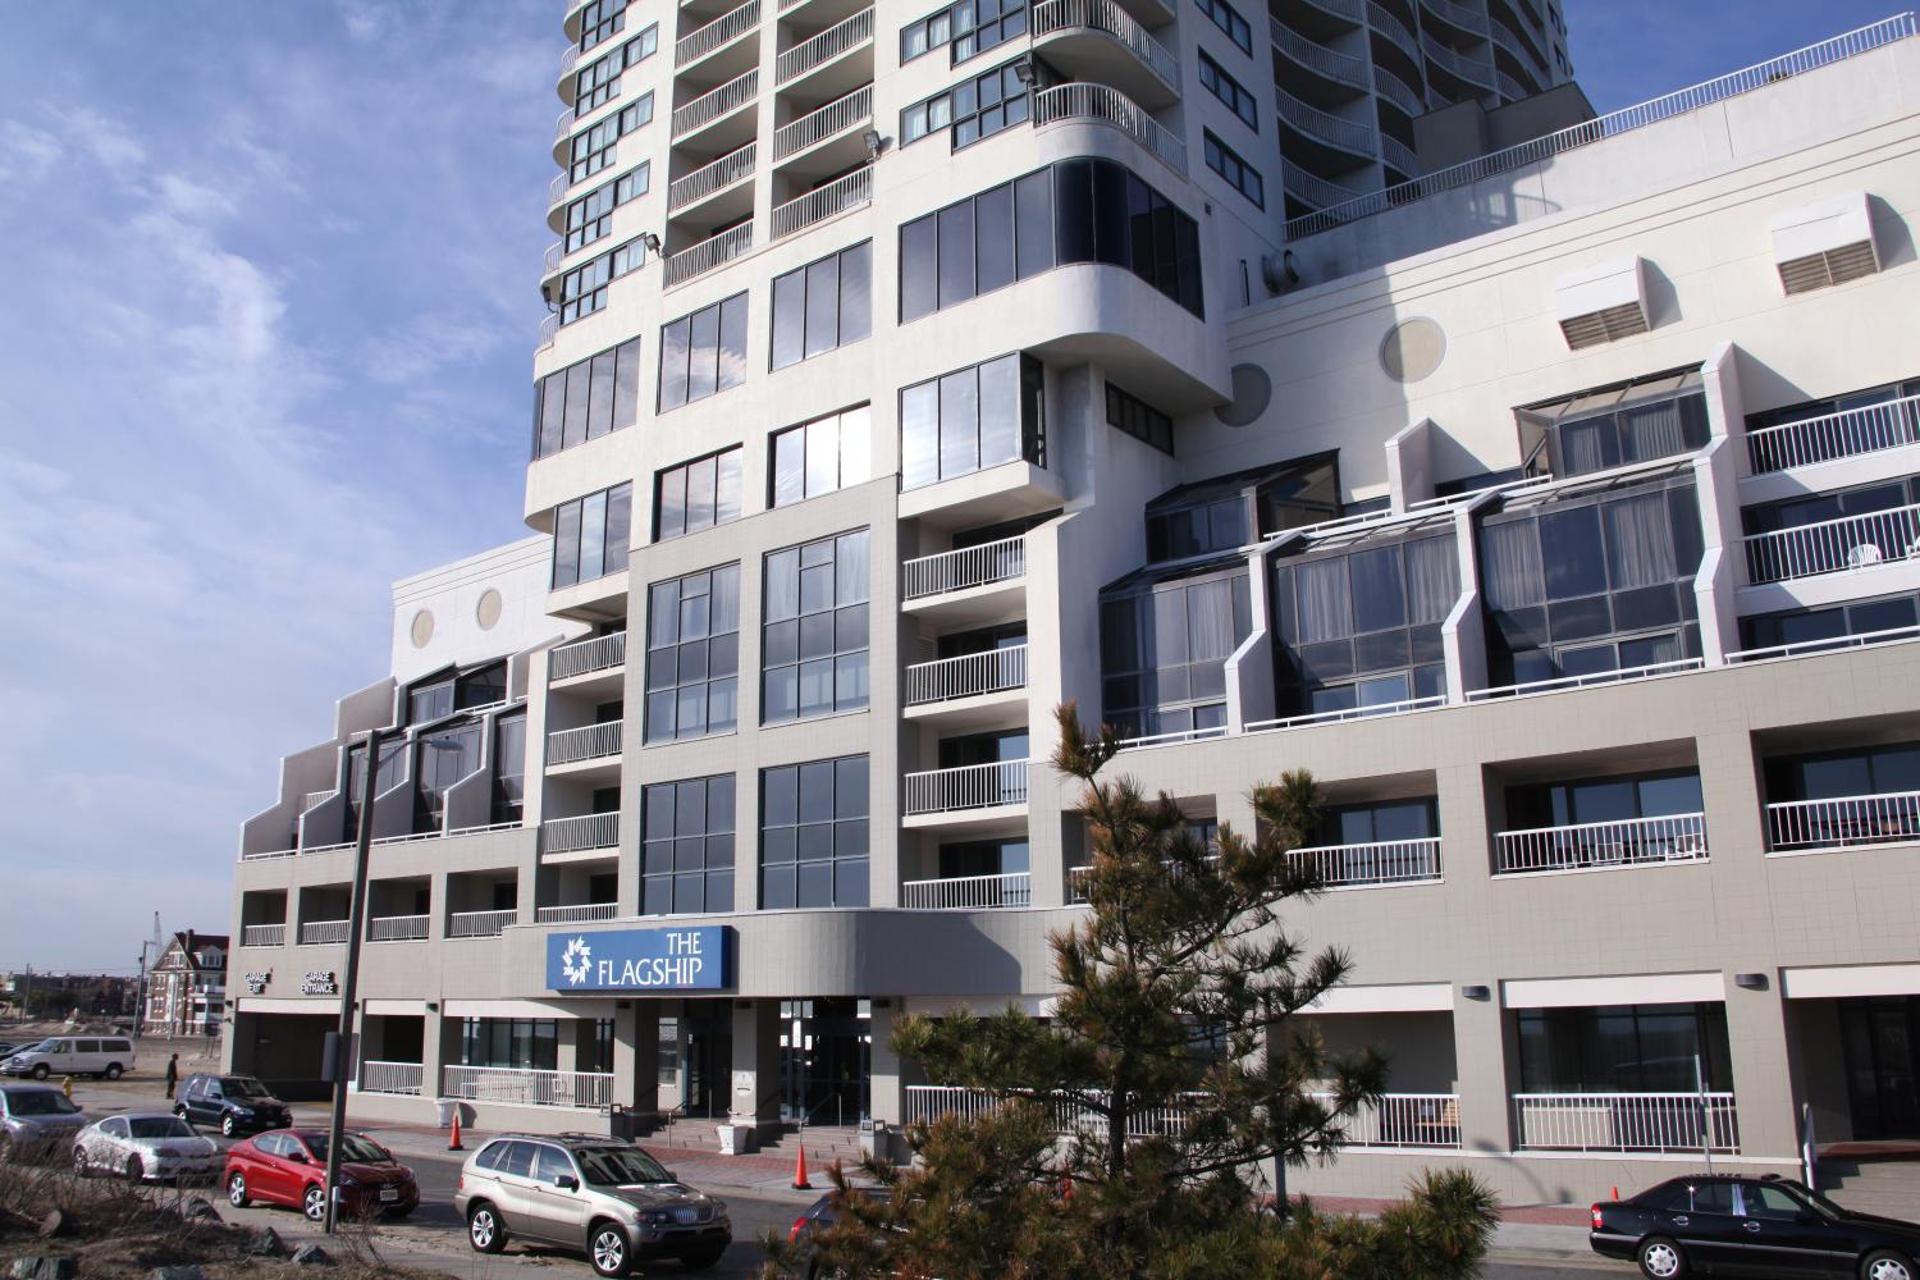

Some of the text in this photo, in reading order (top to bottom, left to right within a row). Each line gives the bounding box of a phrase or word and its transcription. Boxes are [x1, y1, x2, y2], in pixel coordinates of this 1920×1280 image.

[666, 932, 702, 955] THE
[303, 971, 330, 982] GARAGE
[598, 958, 703, 985] FLAGSHIP
[244, 972, 267, 983] GARAGE
[248, 983, 262, 993] EXIT
[300, 982, 334, 993] ENTRANCE
